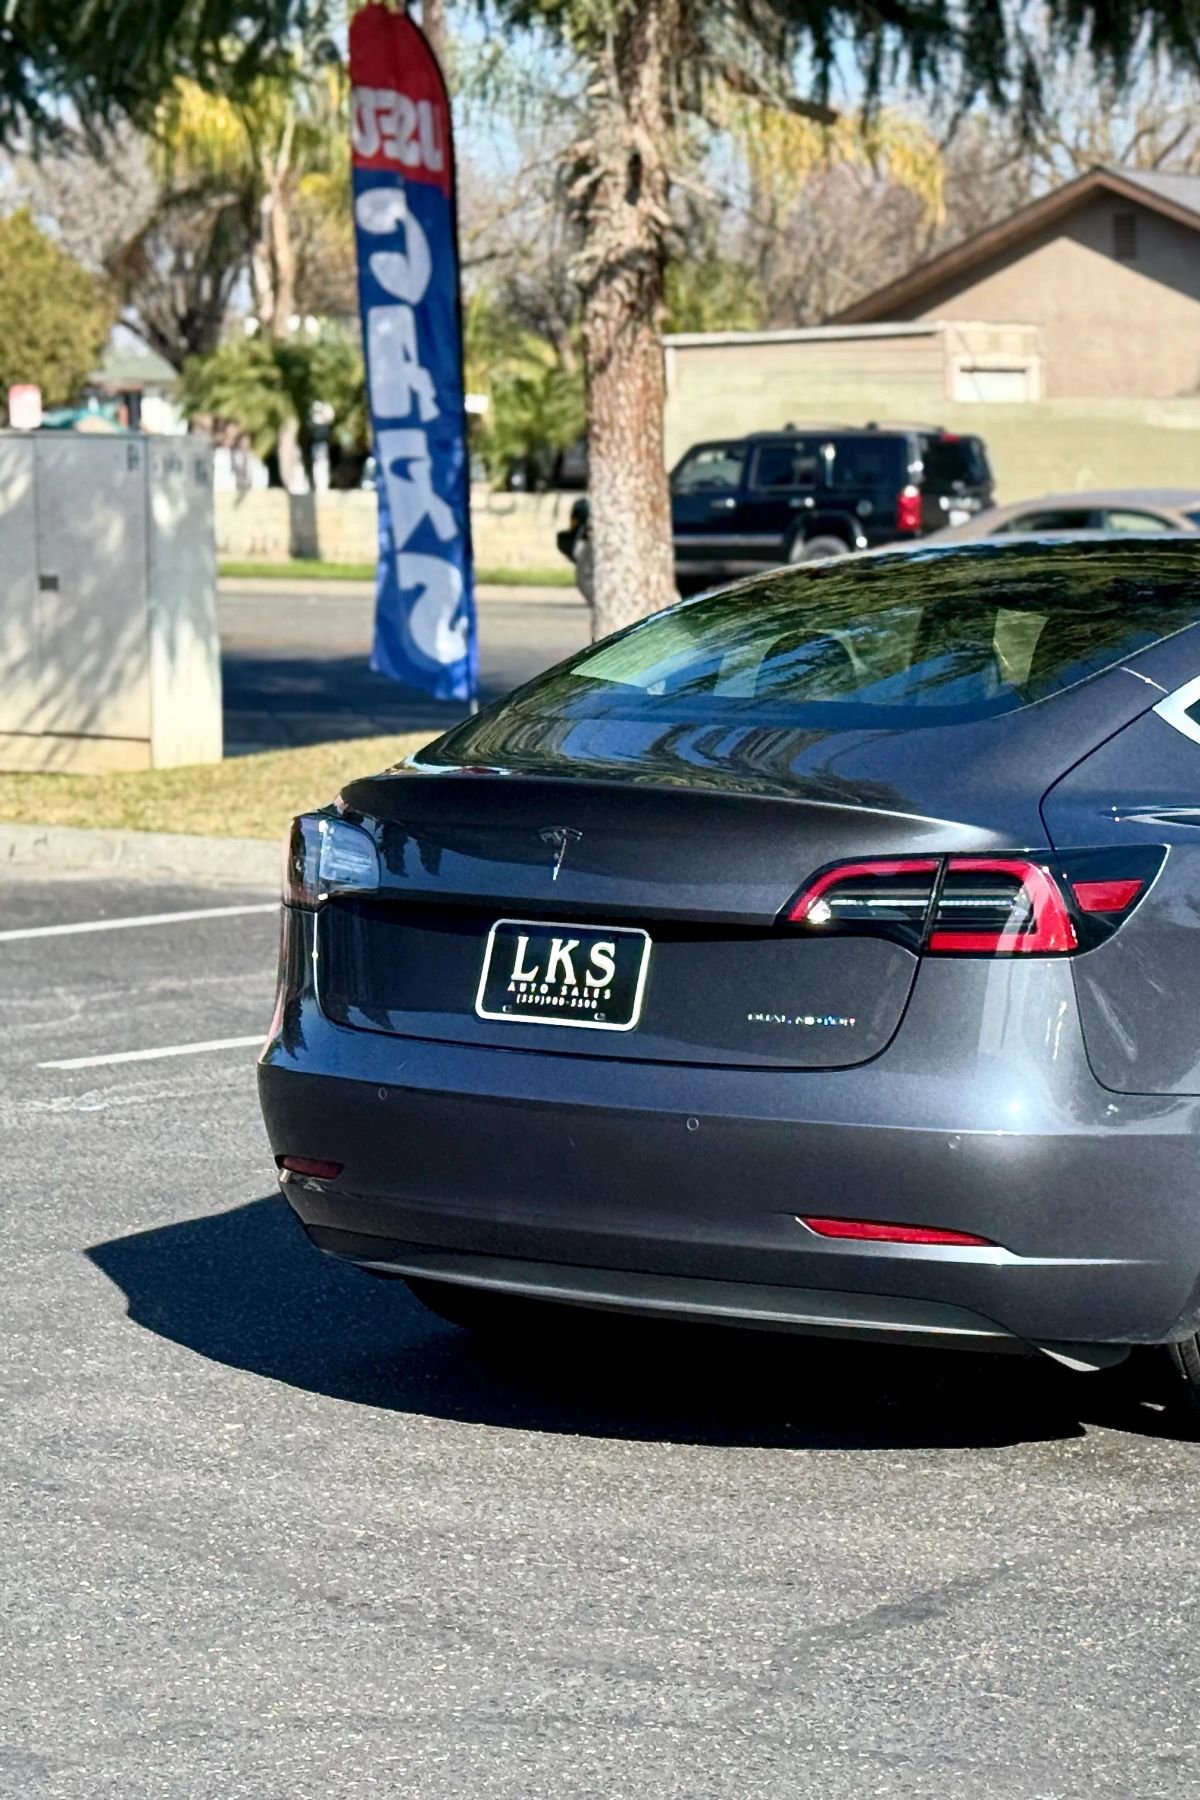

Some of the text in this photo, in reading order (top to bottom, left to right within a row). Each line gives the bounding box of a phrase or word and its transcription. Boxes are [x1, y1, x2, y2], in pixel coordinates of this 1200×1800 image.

[510, 935, 616, 988] LKS
[507, 981, 612, 1000] AUTO SALES
